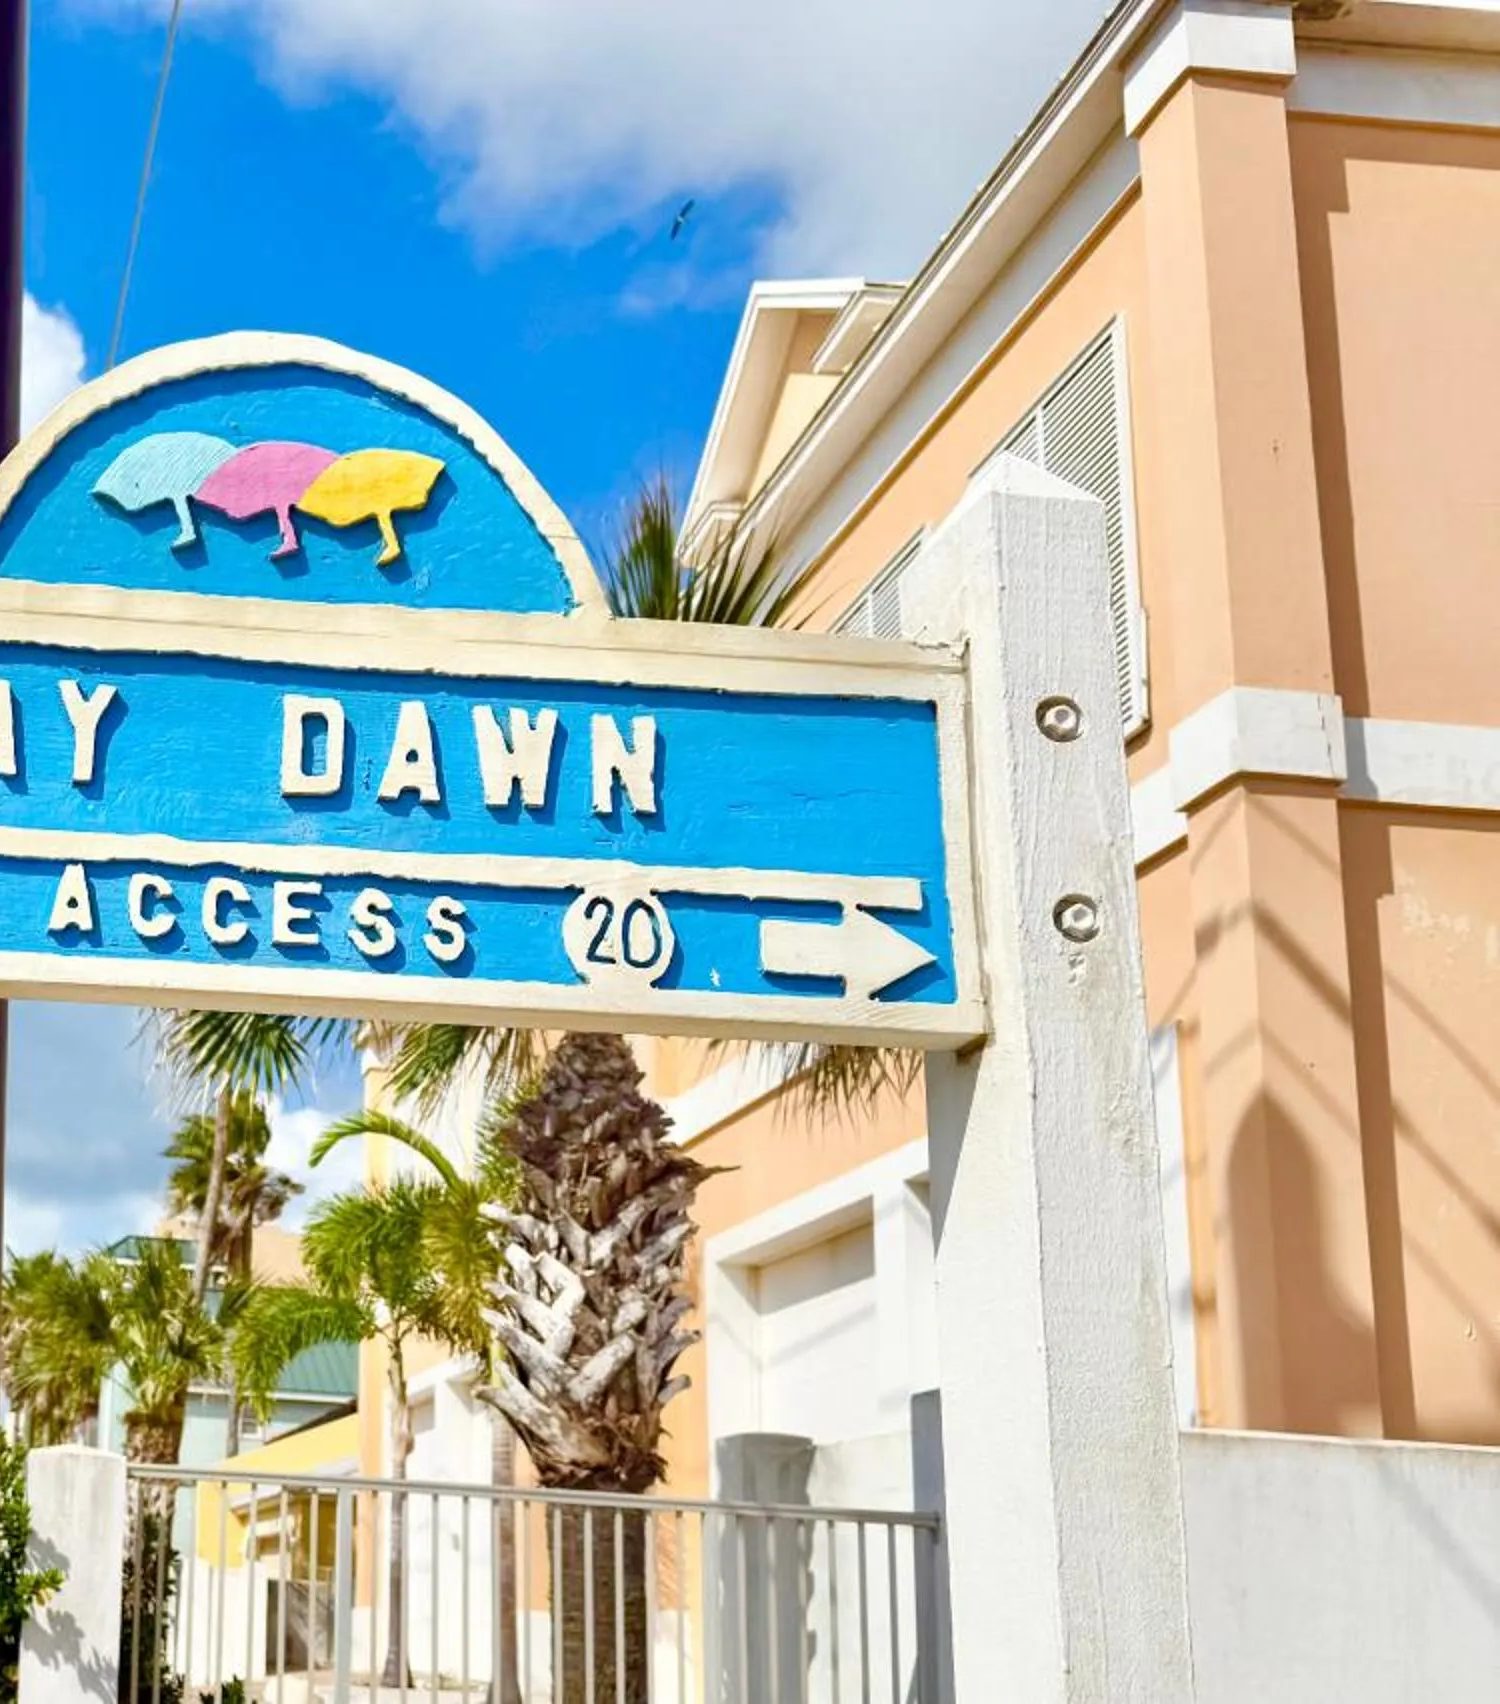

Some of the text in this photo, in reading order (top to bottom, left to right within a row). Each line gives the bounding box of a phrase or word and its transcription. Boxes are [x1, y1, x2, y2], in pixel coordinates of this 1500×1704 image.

[282, 694, 657, 815] DAWN
[49, 864, 468, 961] ACCESS
[583, 897, 664, 968] 20
